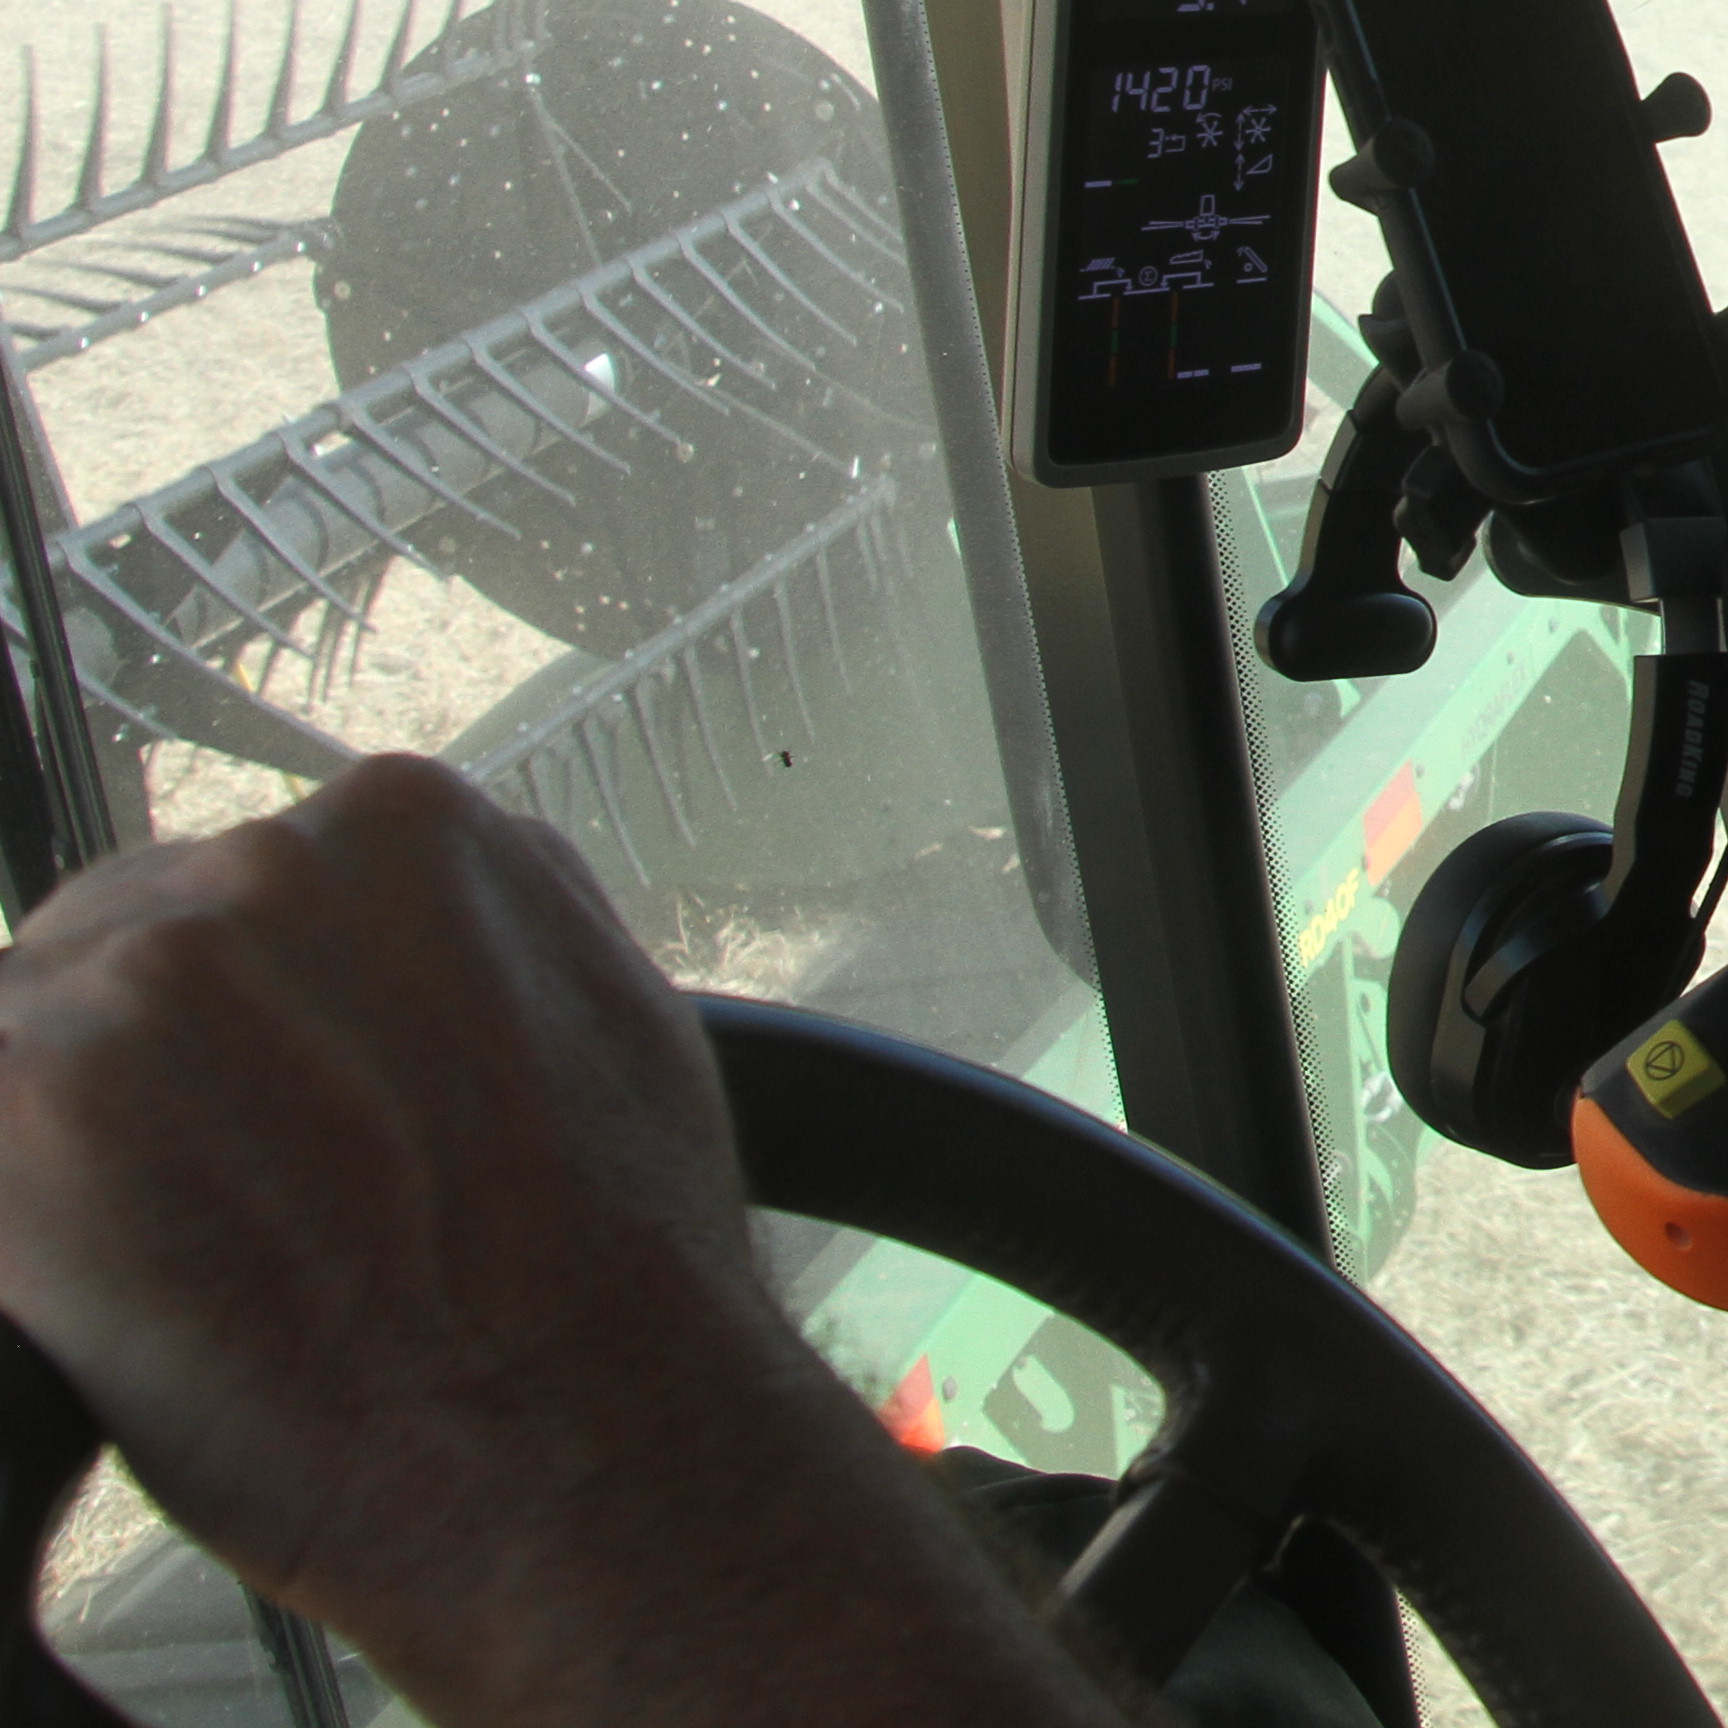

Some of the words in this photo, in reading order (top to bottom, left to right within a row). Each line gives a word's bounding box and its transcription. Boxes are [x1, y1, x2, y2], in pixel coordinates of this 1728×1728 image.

[1111, 64, 1211, 113] 1420
[1212, 77, 1233, 91] PSI
[1299, 867, 1360, 969] RD40F
